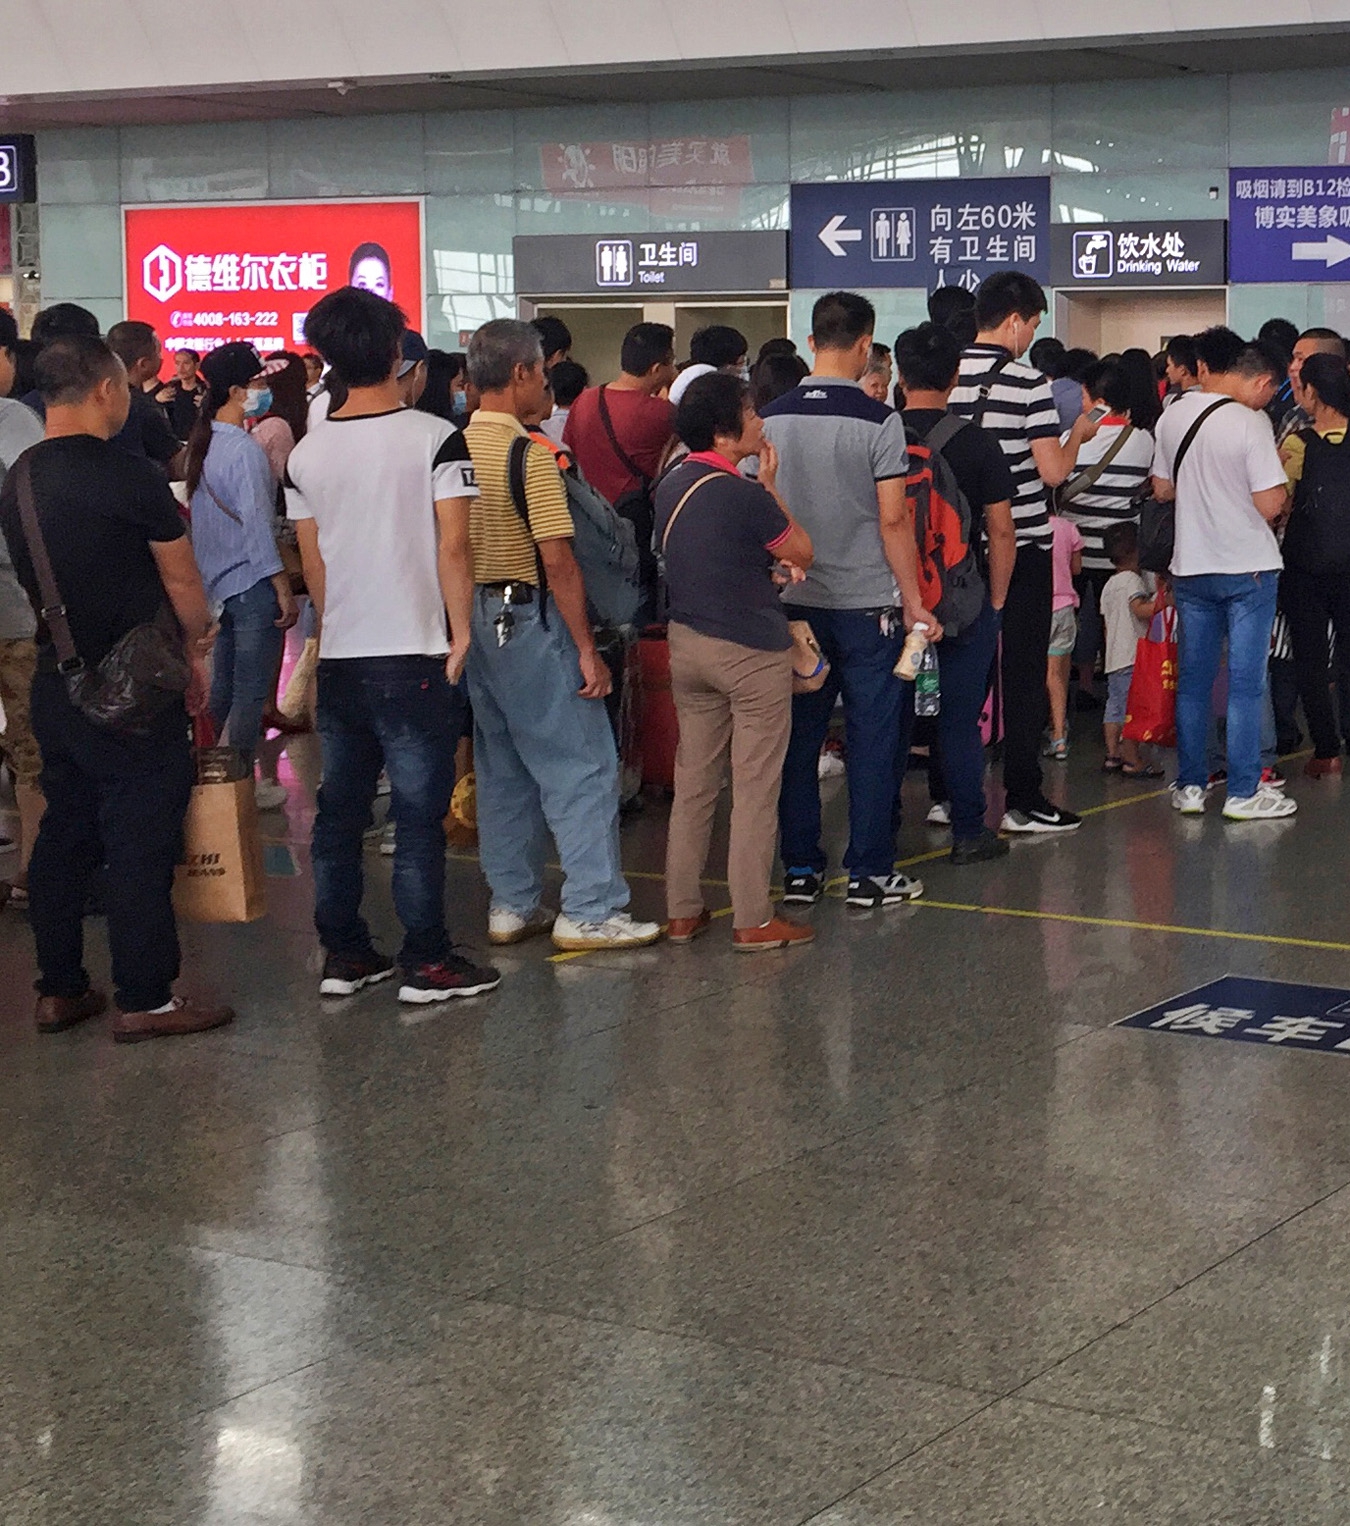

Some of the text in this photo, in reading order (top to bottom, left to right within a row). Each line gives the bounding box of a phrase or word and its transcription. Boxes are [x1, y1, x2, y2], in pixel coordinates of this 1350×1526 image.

[930, 201, 1037, 232] 向左60米
[638, 241, 698, 267] 卫生间
[929, 234, 1037, 265] 有卫生间
[1116, 231, 1186, 259] 饮水处
[185, 252, 328, 292] 德维尔衣柜
[638, 270, 665, 284] Toilet
[1117, 258, 1200, 275] Drinking Water
[193, 311, 279, 326] 4008-163-222
